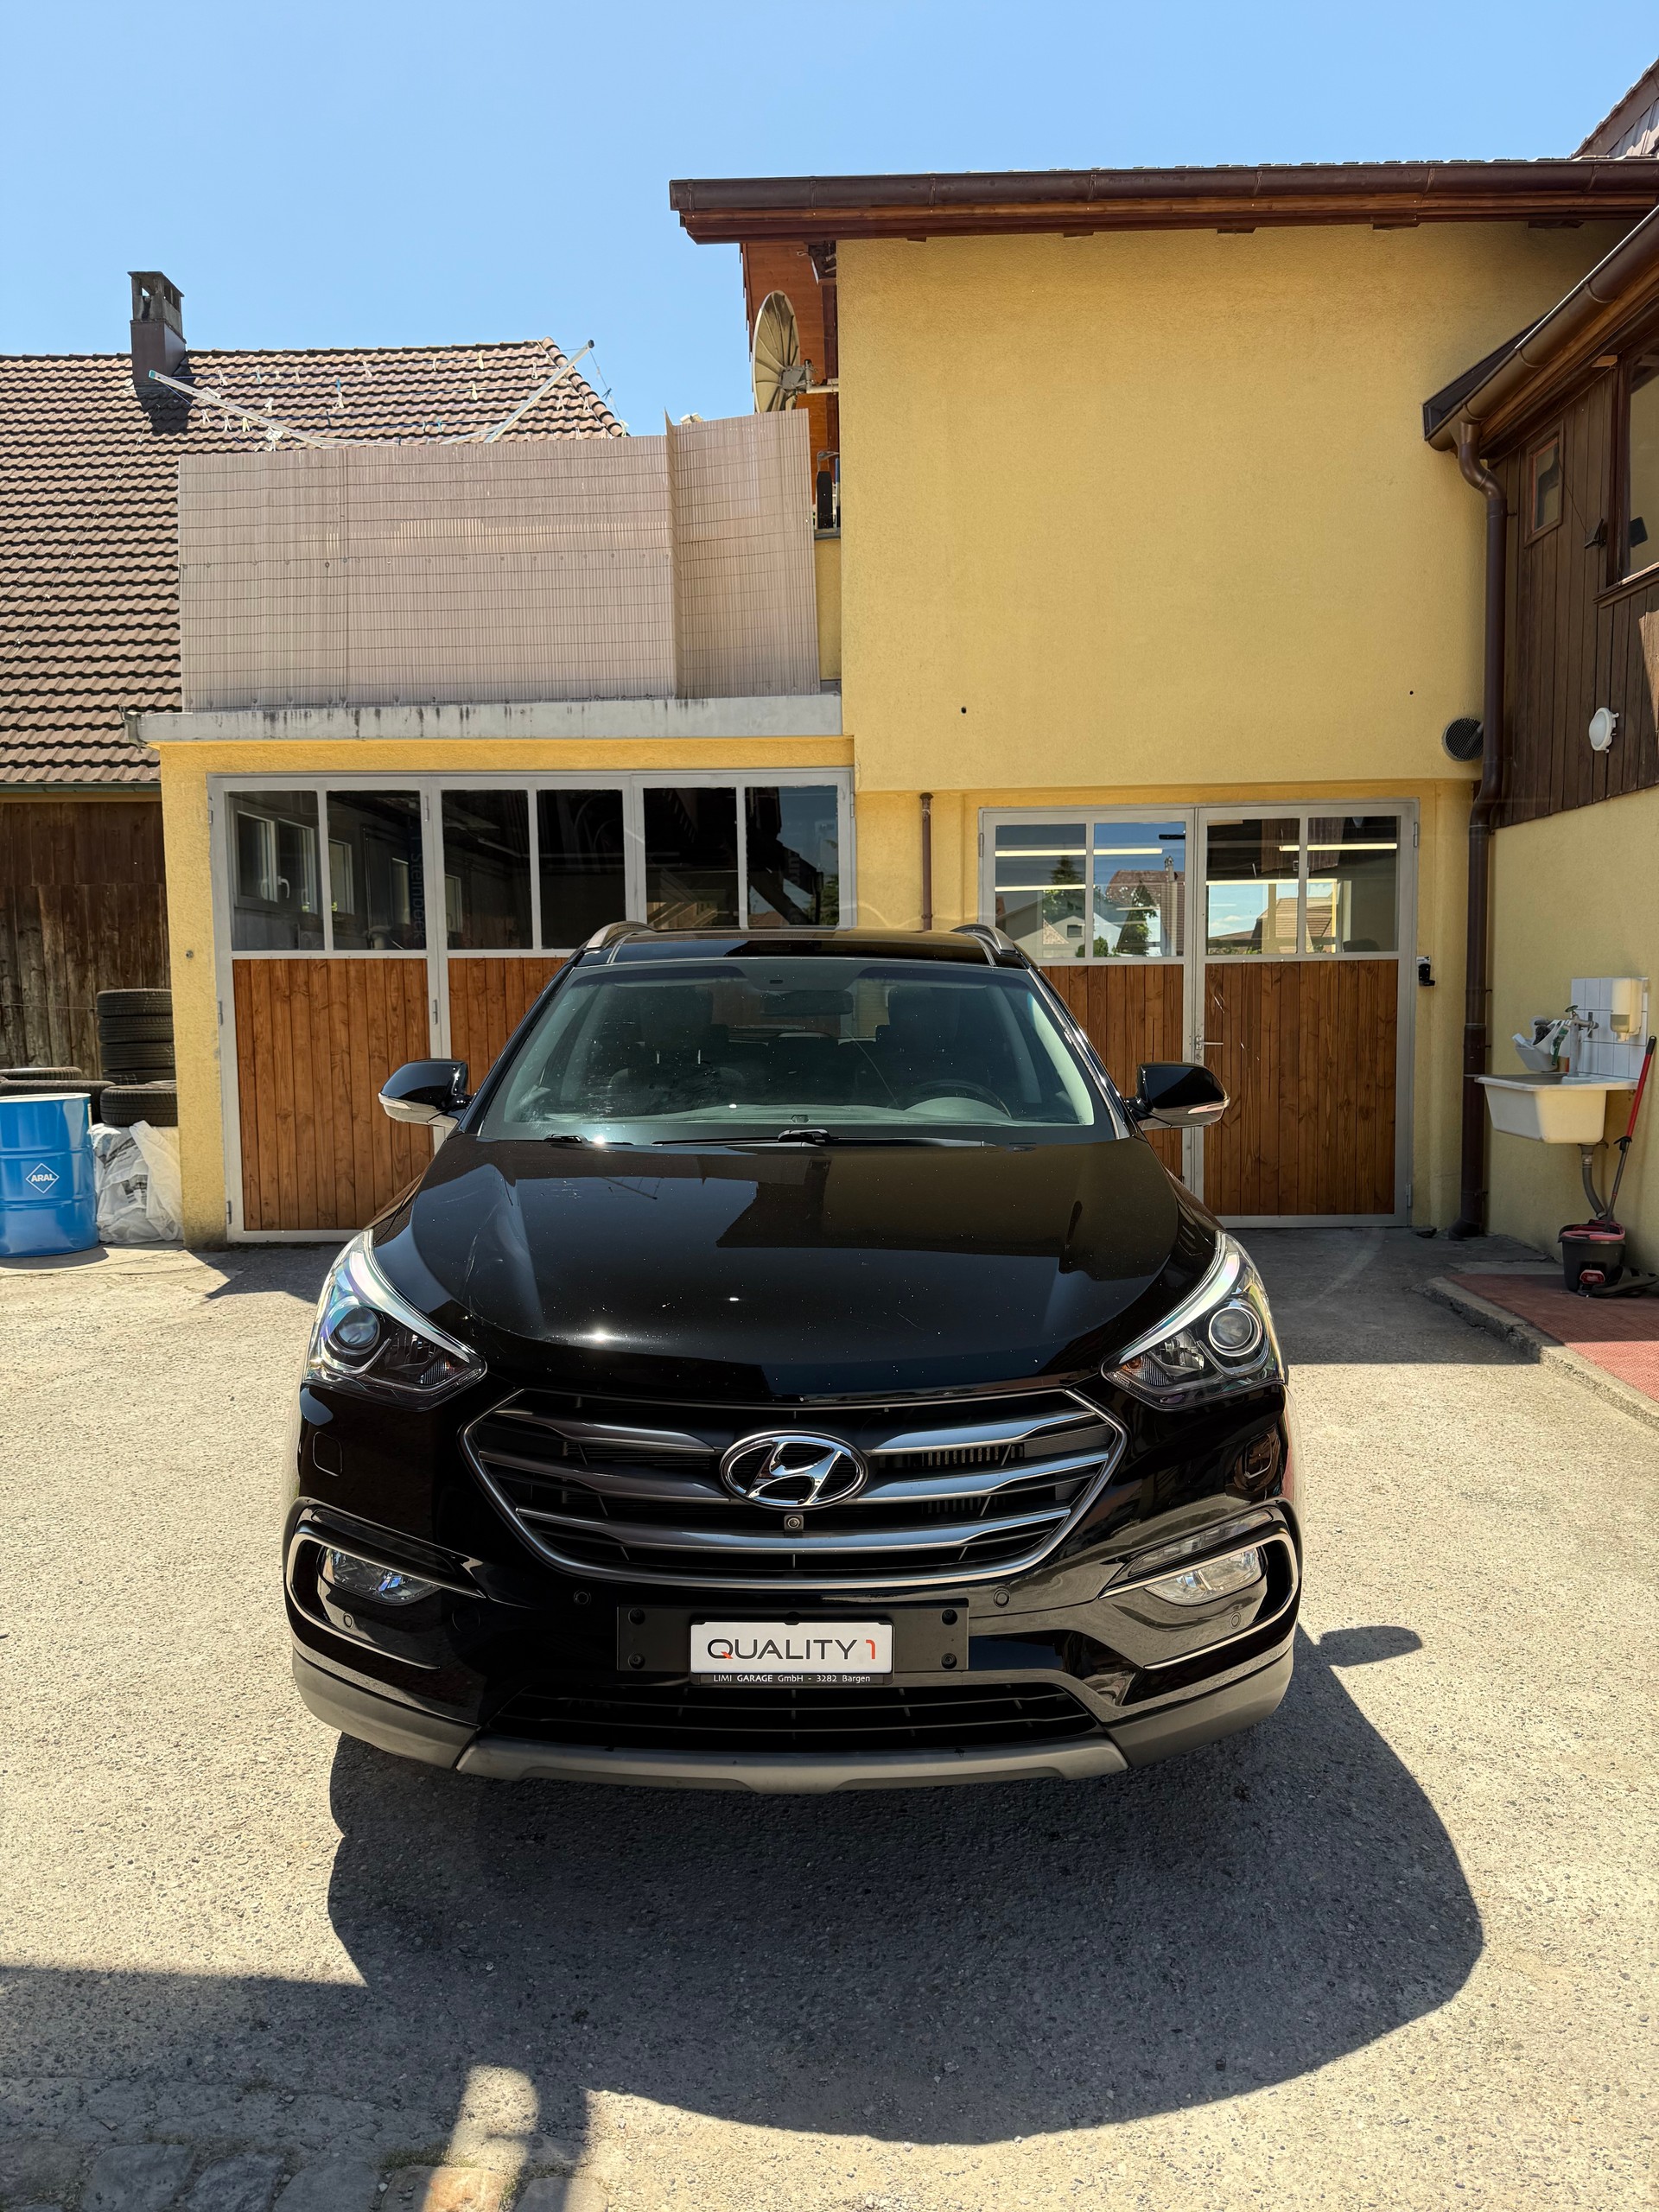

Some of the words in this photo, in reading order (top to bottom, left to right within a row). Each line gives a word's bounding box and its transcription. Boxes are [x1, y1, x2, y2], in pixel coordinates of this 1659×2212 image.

[31, 1173, 55, 1182] ARAL
[707, 1638, 858, 1660] QUALITY
[842, 1675, 871, 1684] Bargen
